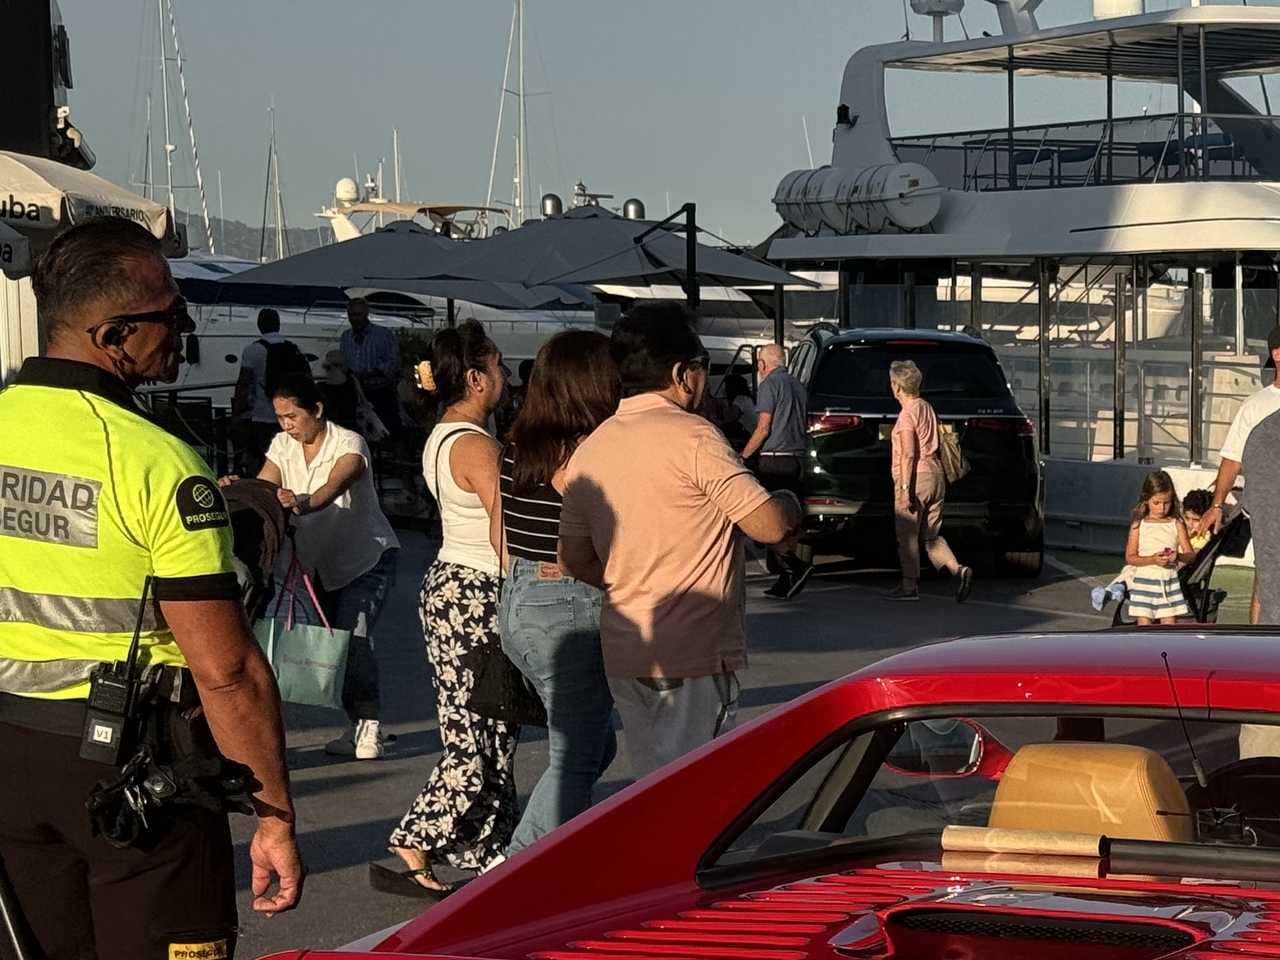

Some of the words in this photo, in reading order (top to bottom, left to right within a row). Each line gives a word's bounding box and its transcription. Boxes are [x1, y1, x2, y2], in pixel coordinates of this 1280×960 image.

[0, 241, 13, 263] a
[2, 472, 94, 512] RIDAD
[0, 507, 70, 540] EGUR
[96, 729, 109, 740] V1
